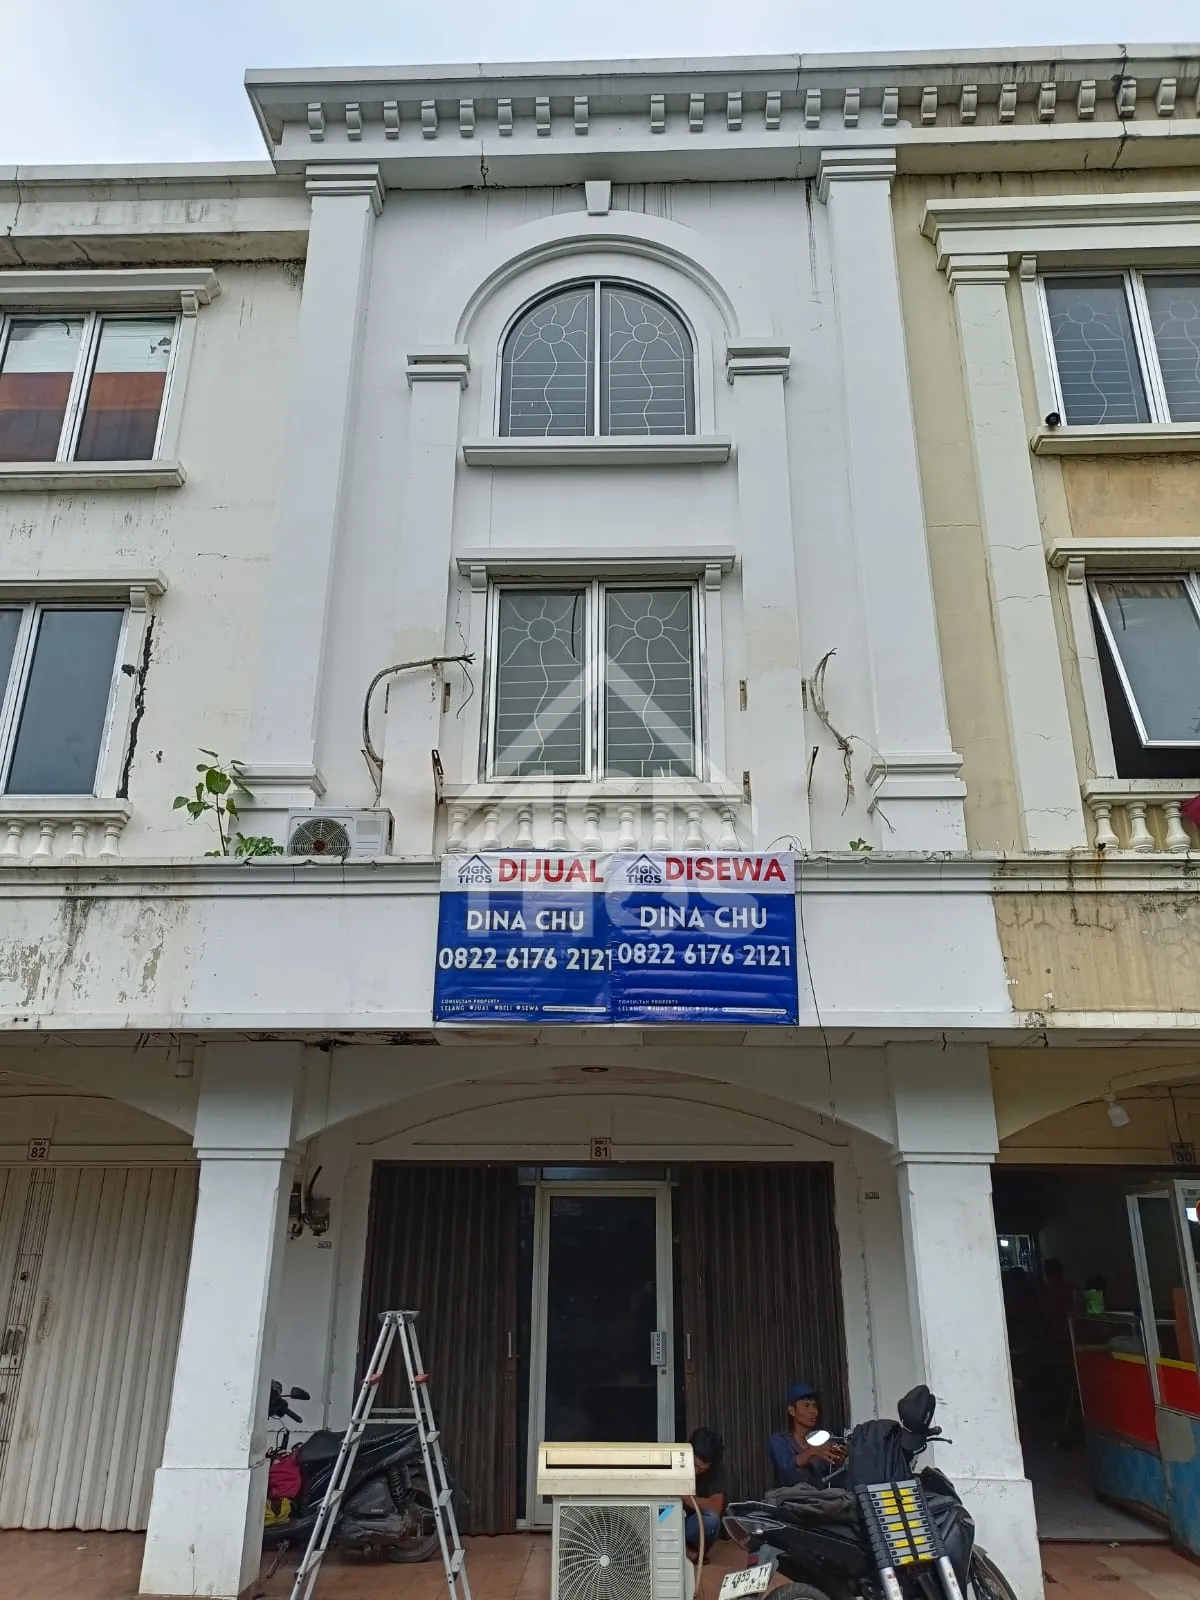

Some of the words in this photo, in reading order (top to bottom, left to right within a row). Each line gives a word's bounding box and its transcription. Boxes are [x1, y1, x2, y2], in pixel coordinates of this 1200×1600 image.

[498, 857, 604, 883] DIJUAL
[665, 856, 787, 881] DISEWA
[466, 910, 526, 931] DINA
[535, 911, 584, 931] CHU
[640, 906, 705, 929] DINA
[714, 907, 767, 929] CHU
[438, 947, 497, 969] 0822
[505, 948, 558, 969] 6176
[566, 948, 612, 971] 2121
[617, 943, 675, 965] 0822
[684, 944, 735, 965] 6176
[743, 945, 791, 967] 2121
[30, 1147, 46, 1158] 82
[594, 1146, 608, 1157] 81
